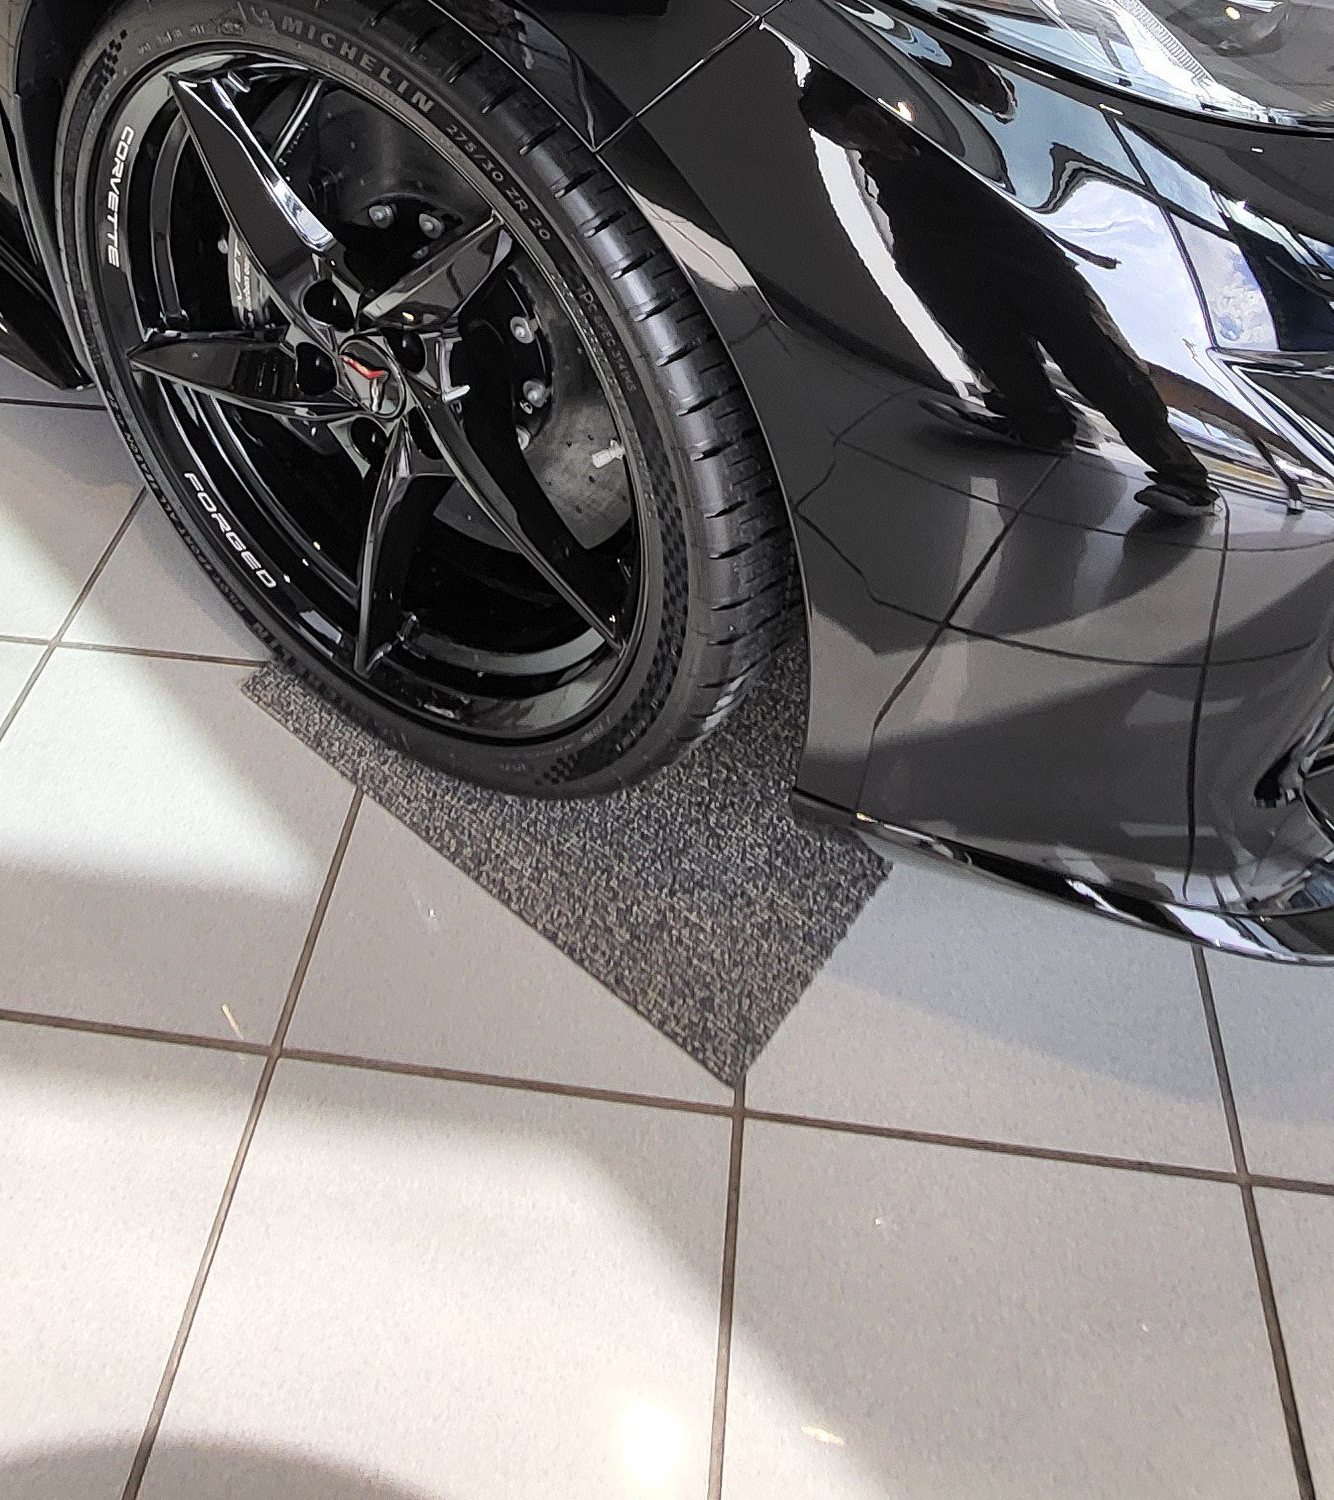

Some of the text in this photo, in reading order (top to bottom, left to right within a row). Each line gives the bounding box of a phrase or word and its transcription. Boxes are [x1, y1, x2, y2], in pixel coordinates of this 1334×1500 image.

[281, 15, 435, 114] MICHELIN
[106, 125, 135, 269] CORVETTE
[445, 123, 551, 241] 275/30 ZR 20
[184, 471, 277, 589] FORGED
